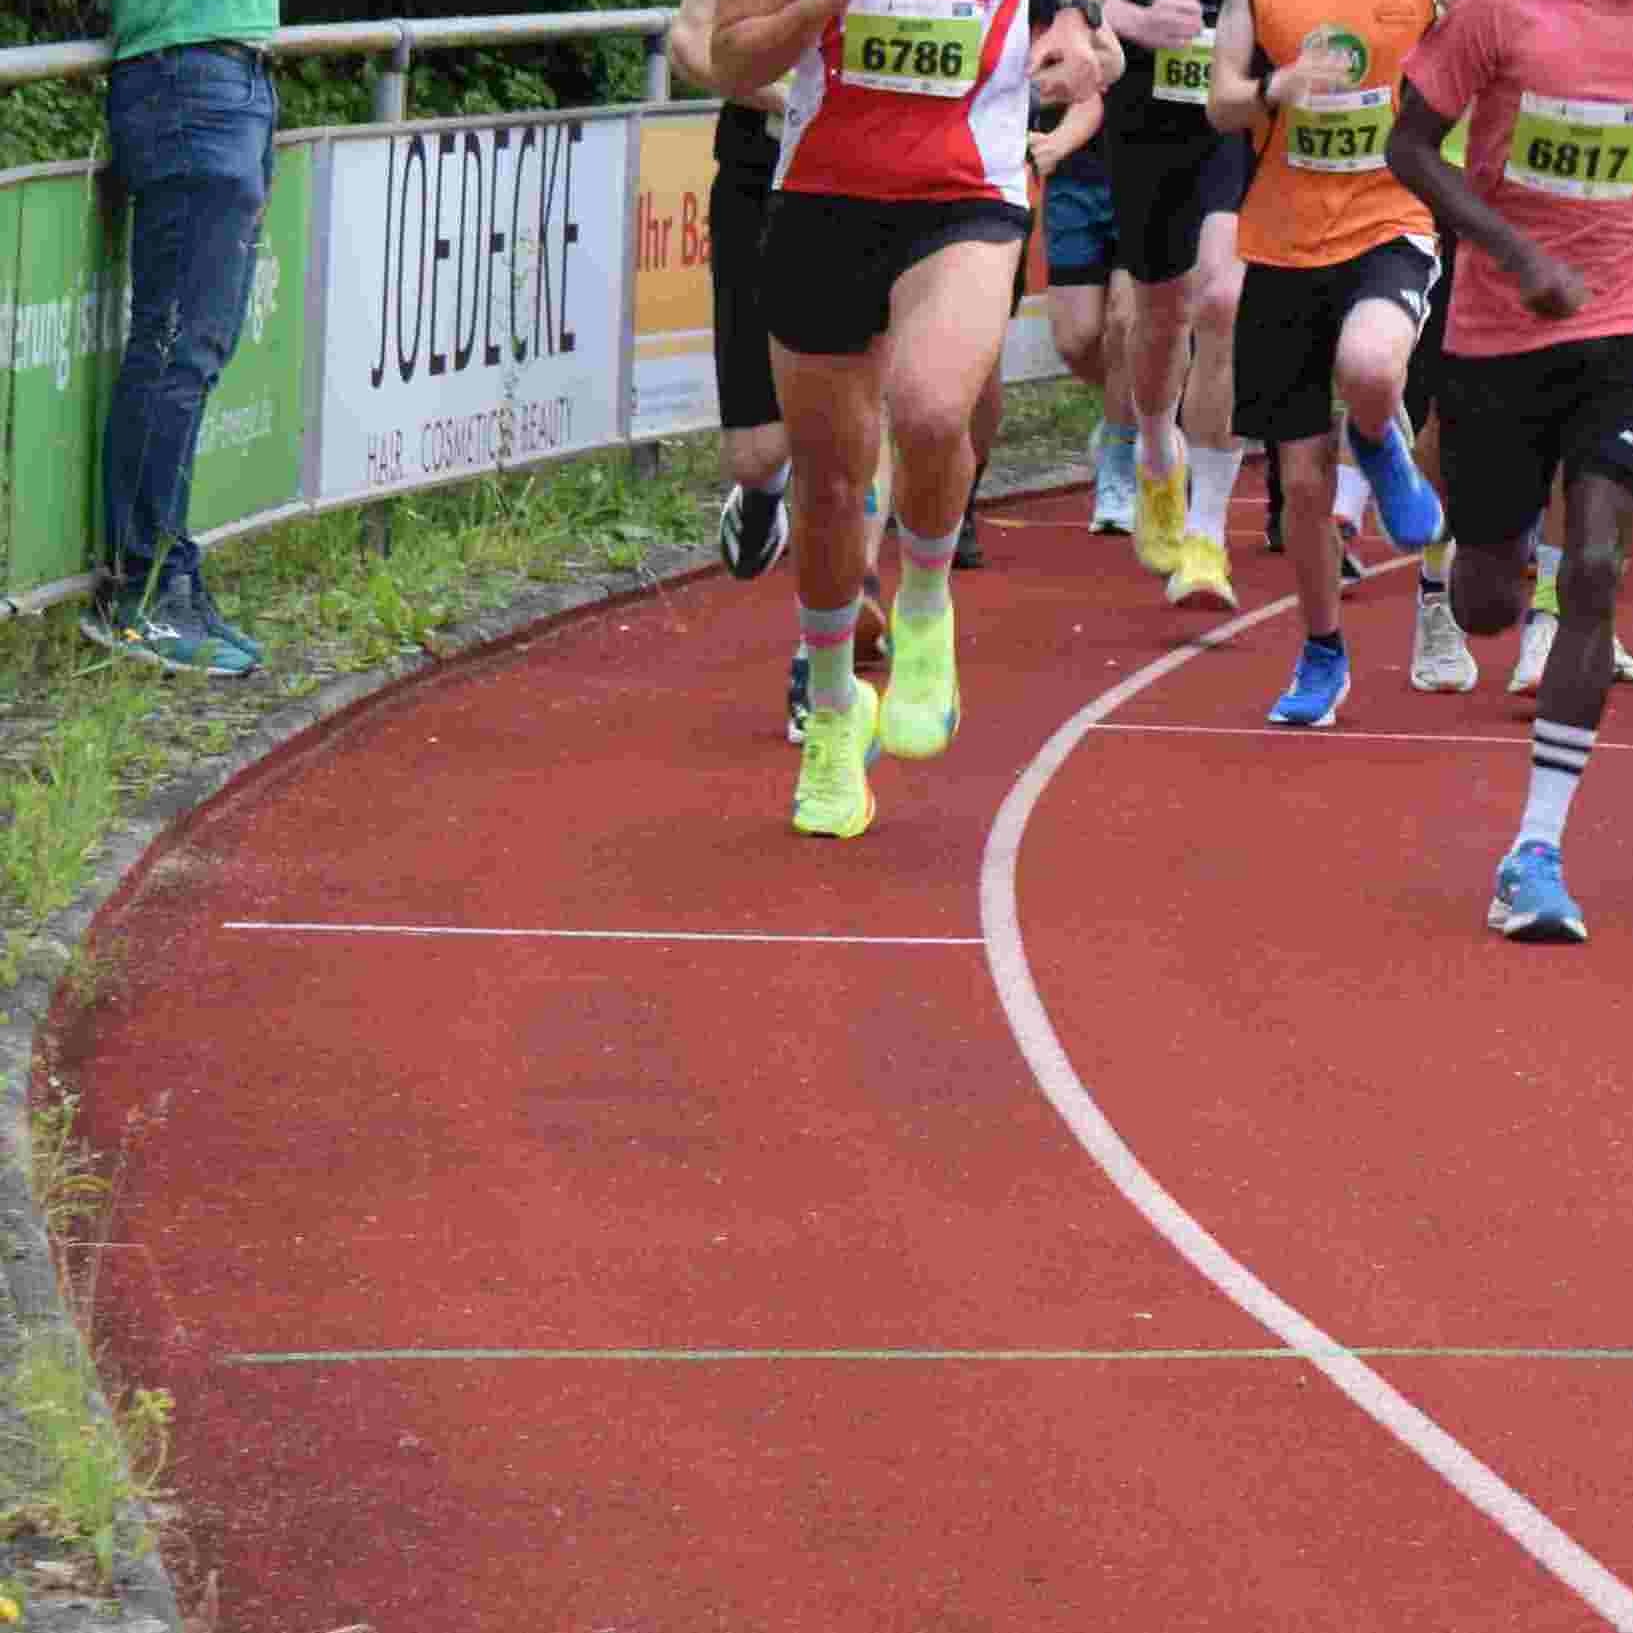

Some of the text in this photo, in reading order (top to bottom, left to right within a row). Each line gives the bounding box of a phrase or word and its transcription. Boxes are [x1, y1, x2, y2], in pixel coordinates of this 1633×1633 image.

[863, 37, 962, 77] 6786
[1296, 125, 1378, 157] 6737
[1527, 137, 1630, 181] 6817
[637, 189, 672, 272] Ihr
[371, 122, 584, 389] JOEDECKE
